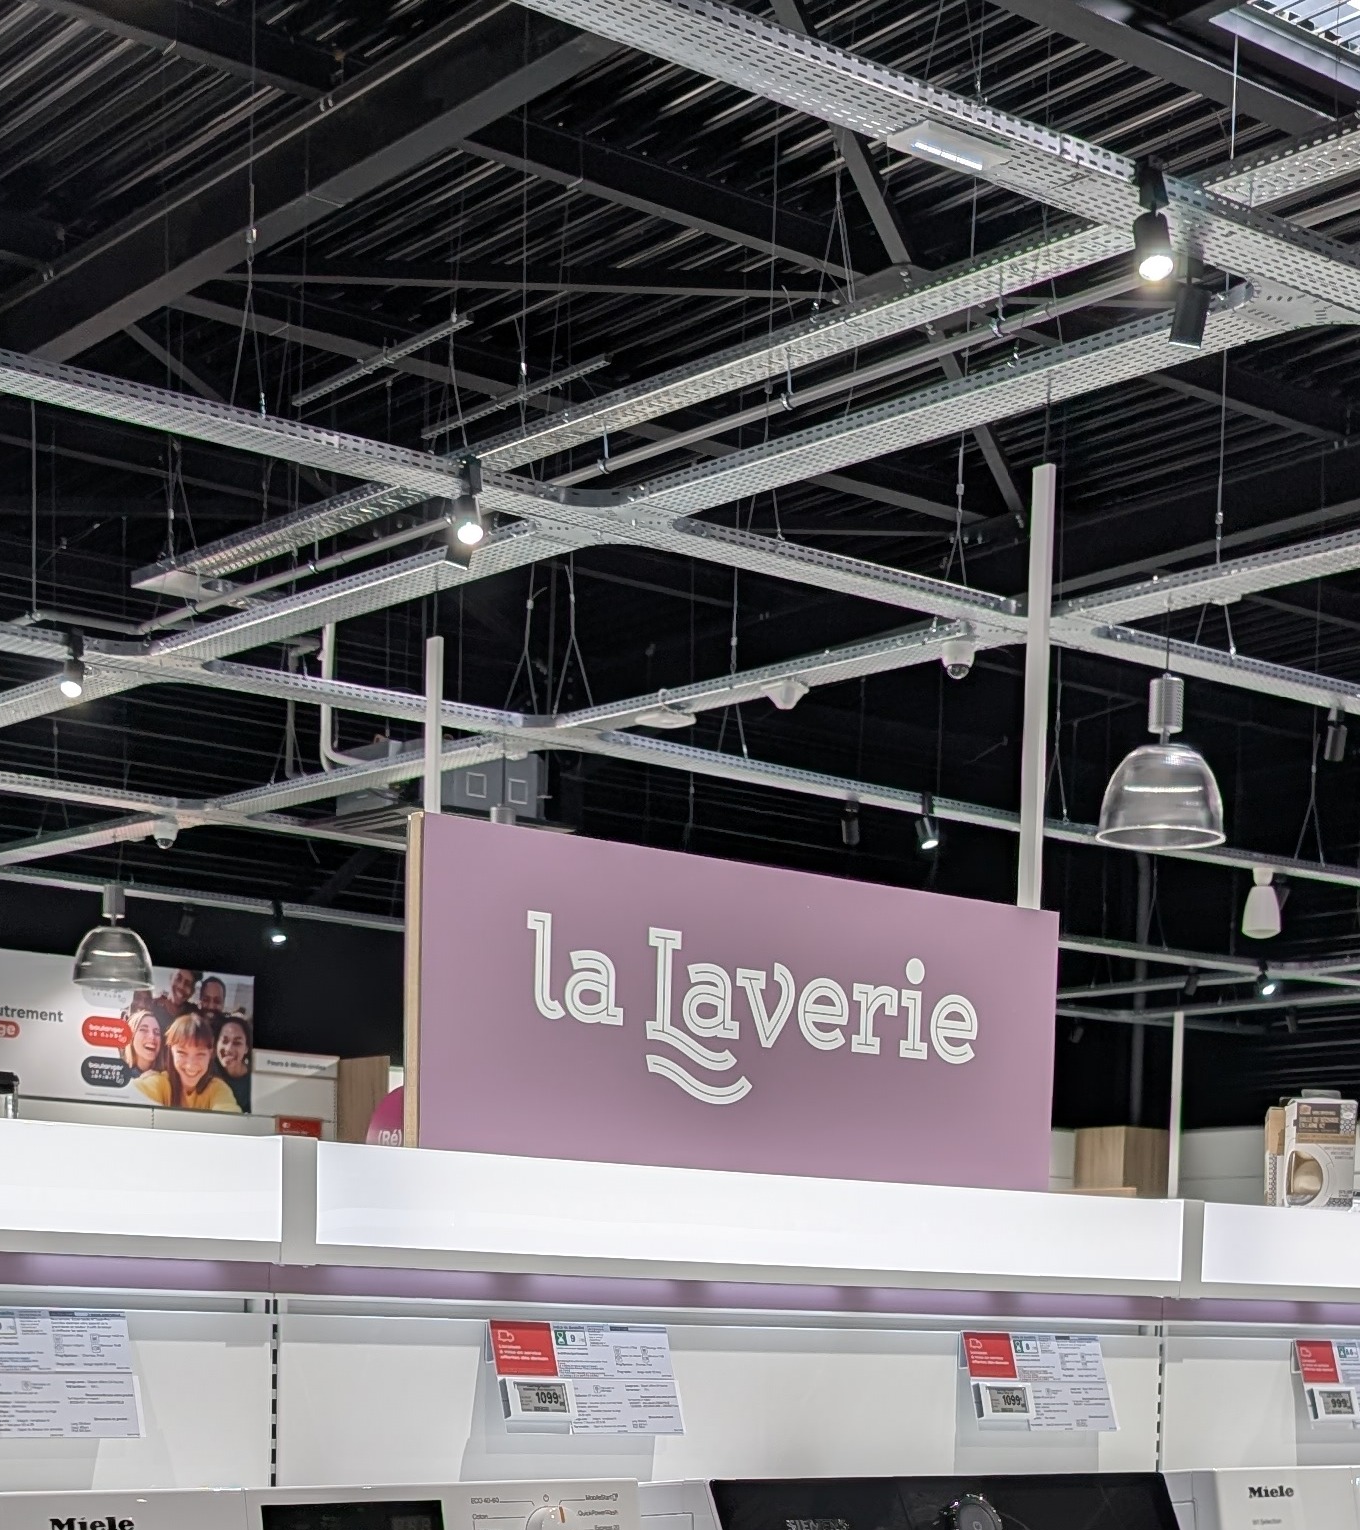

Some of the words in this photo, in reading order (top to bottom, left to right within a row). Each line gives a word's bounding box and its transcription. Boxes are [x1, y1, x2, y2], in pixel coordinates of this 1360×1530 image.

[527, 910, 623, 1026] la
[645, 926, 978, 1104] Laverie
[1248, 1485, 1294, 1498] Miele
